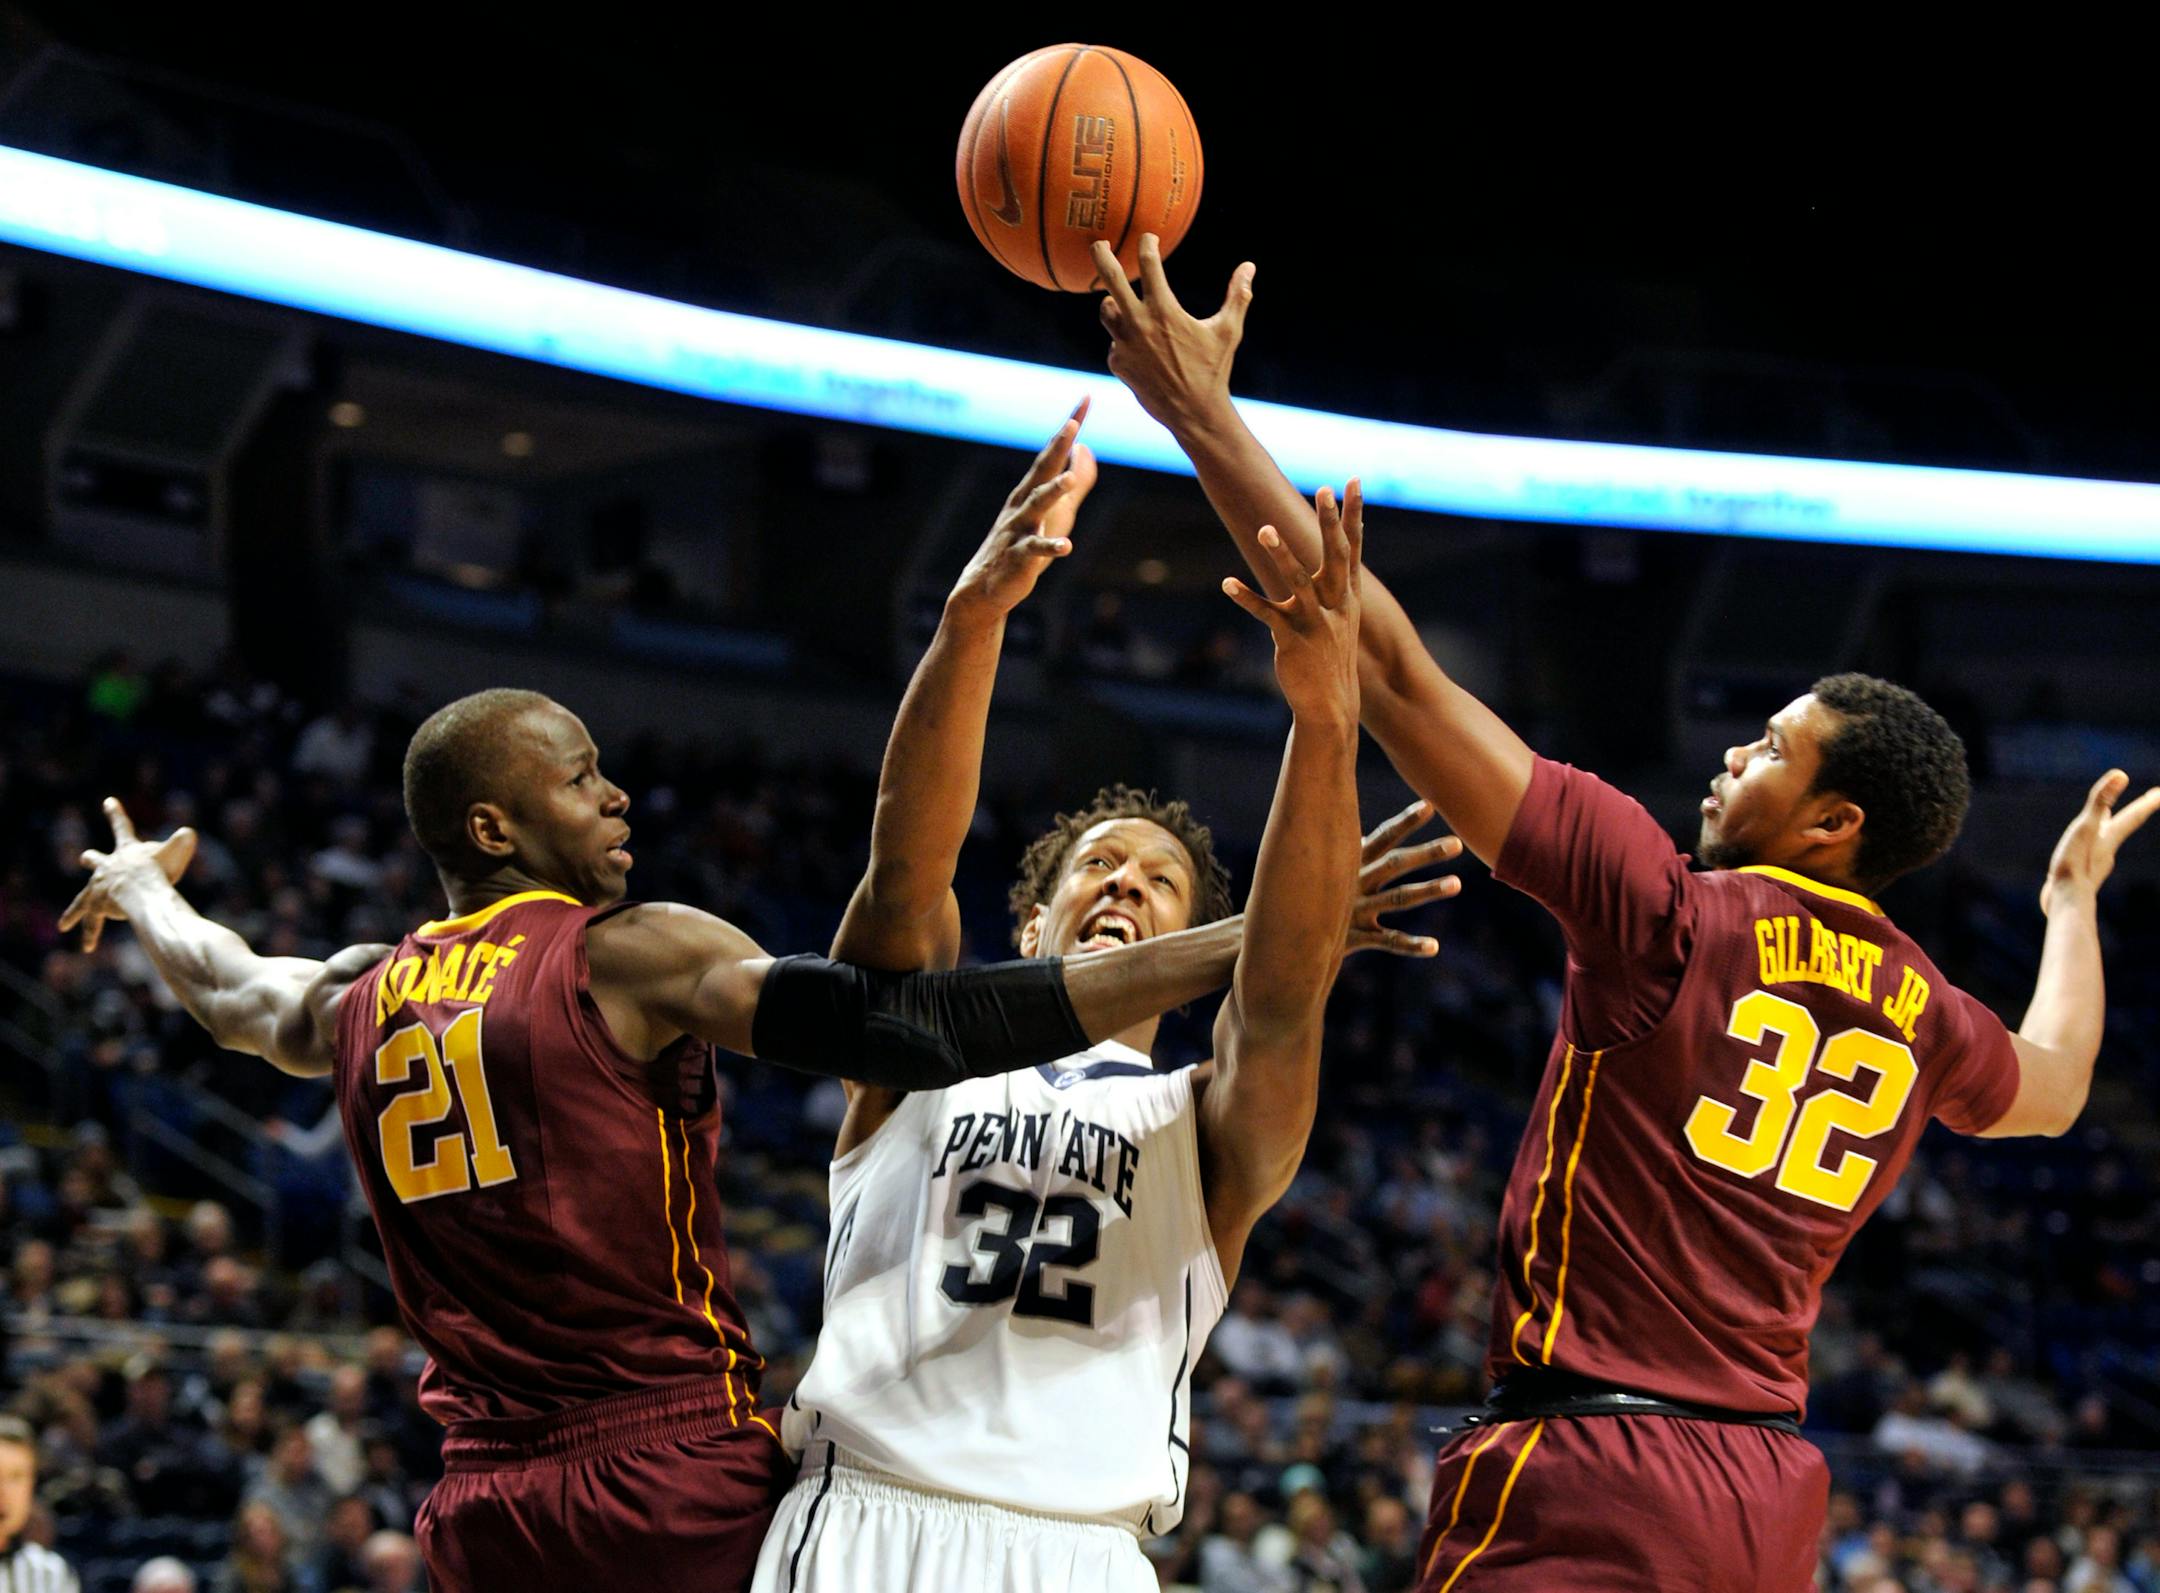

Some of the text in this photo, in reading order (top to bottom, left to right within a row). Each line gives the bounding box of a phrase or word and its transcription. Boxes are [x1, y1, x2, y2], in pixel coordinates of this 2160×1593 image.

[1065, 114, 1107, 231] ELITE
[1097, 117, 1115, 231] CHAMPIONSHIP
[1754, 915, 1931, 1043] GILBERT JR
[375, 1007, 517, 1204] 21
[932, 1105, 1052, 1179] PENN
[1683, 989, 1919, 1212] 32
[936, 1180, 1103, 1330] 32
